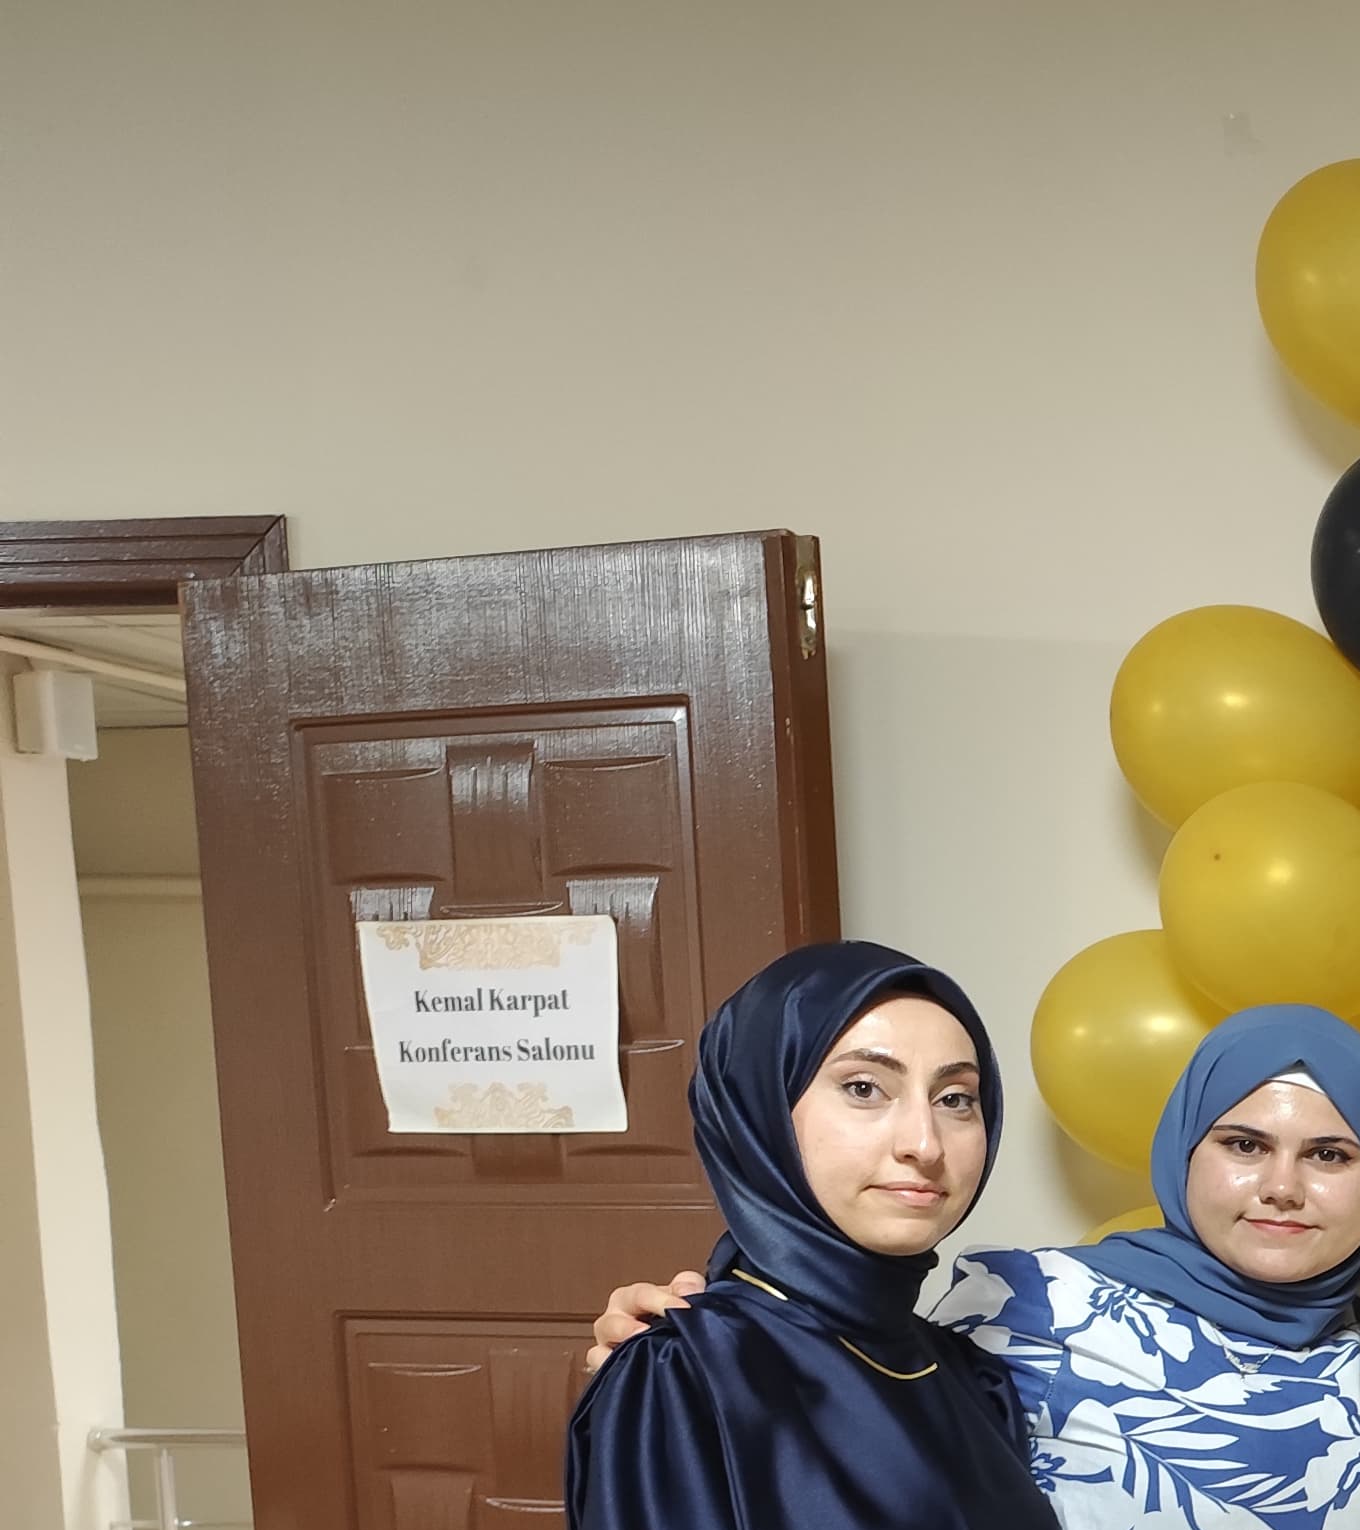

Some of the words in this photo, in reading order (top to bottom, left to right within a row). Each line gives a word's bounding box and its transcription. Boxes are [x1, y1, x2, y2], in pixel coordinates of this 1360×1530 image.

[414, 987, 483, 1013] Kemal
[489, 988, 571, 1017] Karpat
[399, 1038, 513, 1063] Konferans
[516, 1037, 596, 1062] Salonu
